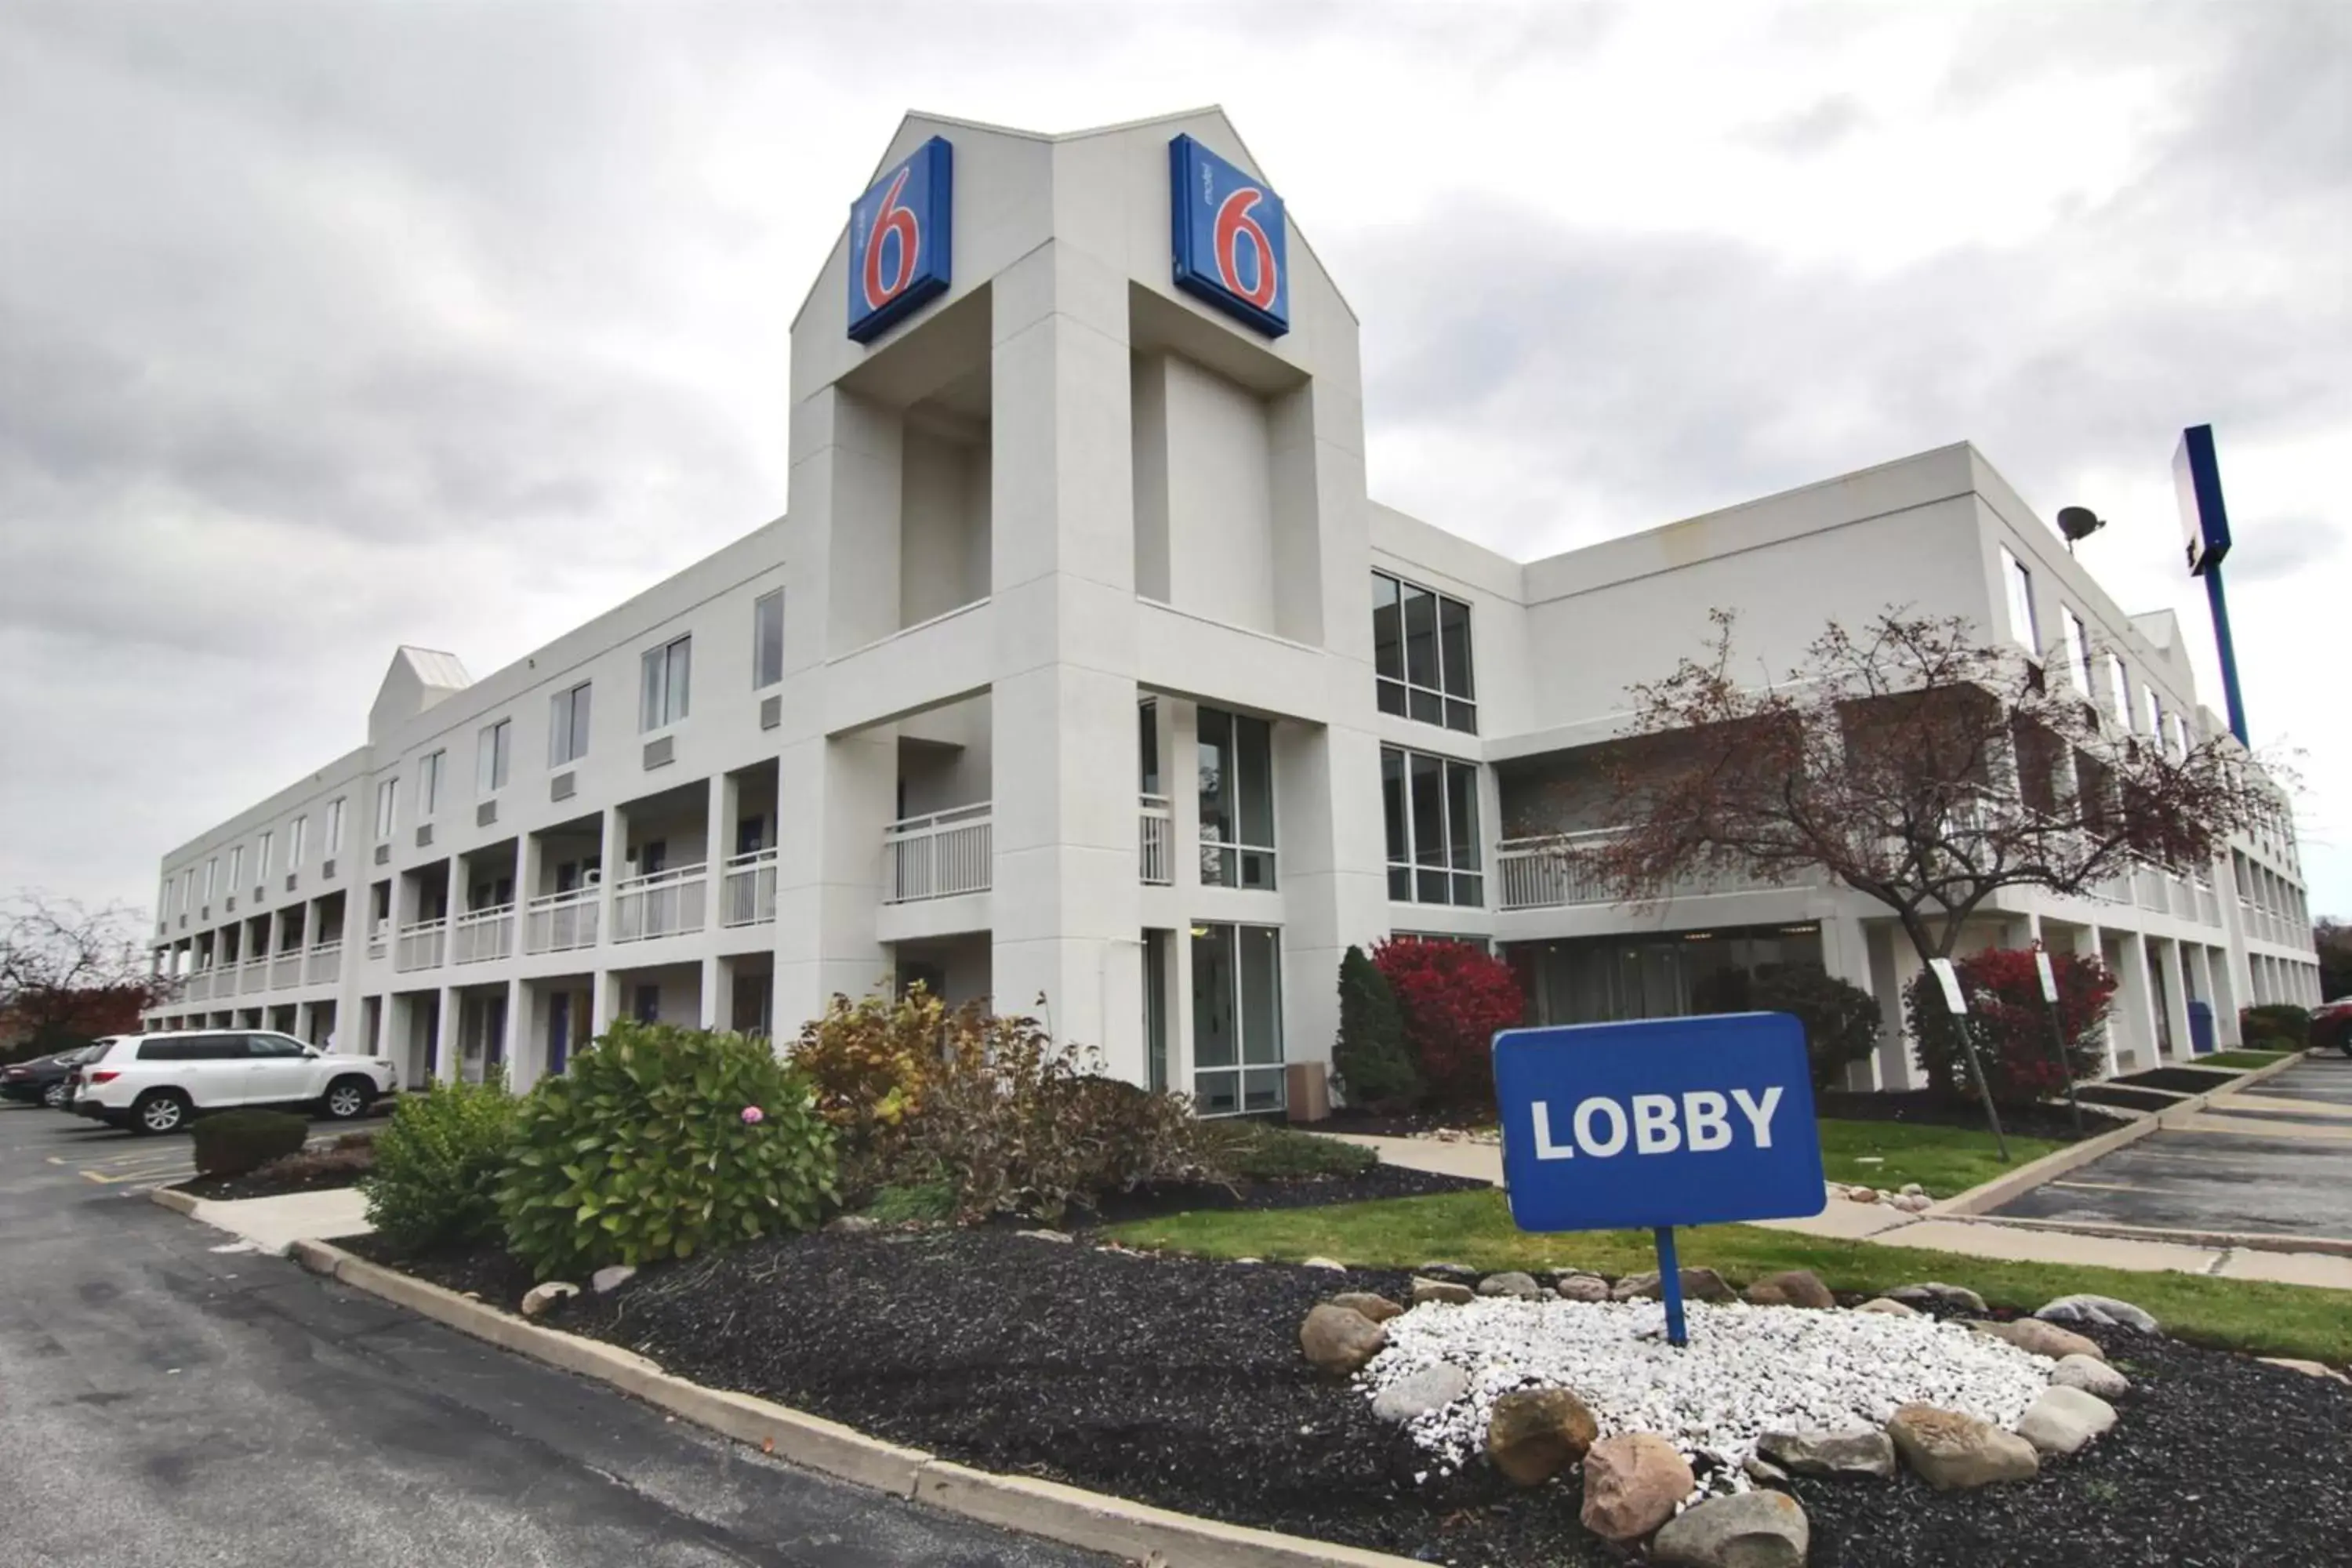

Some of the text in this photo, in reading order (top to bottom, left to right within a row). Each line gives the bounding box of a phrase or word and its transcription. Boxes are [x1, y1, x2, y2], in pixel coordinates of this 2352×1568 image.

[863, 165, 920, 310] 6
[1213, 187, 1277, 310] 6
[1531, 1087, 1784, 1160] LOBBY
